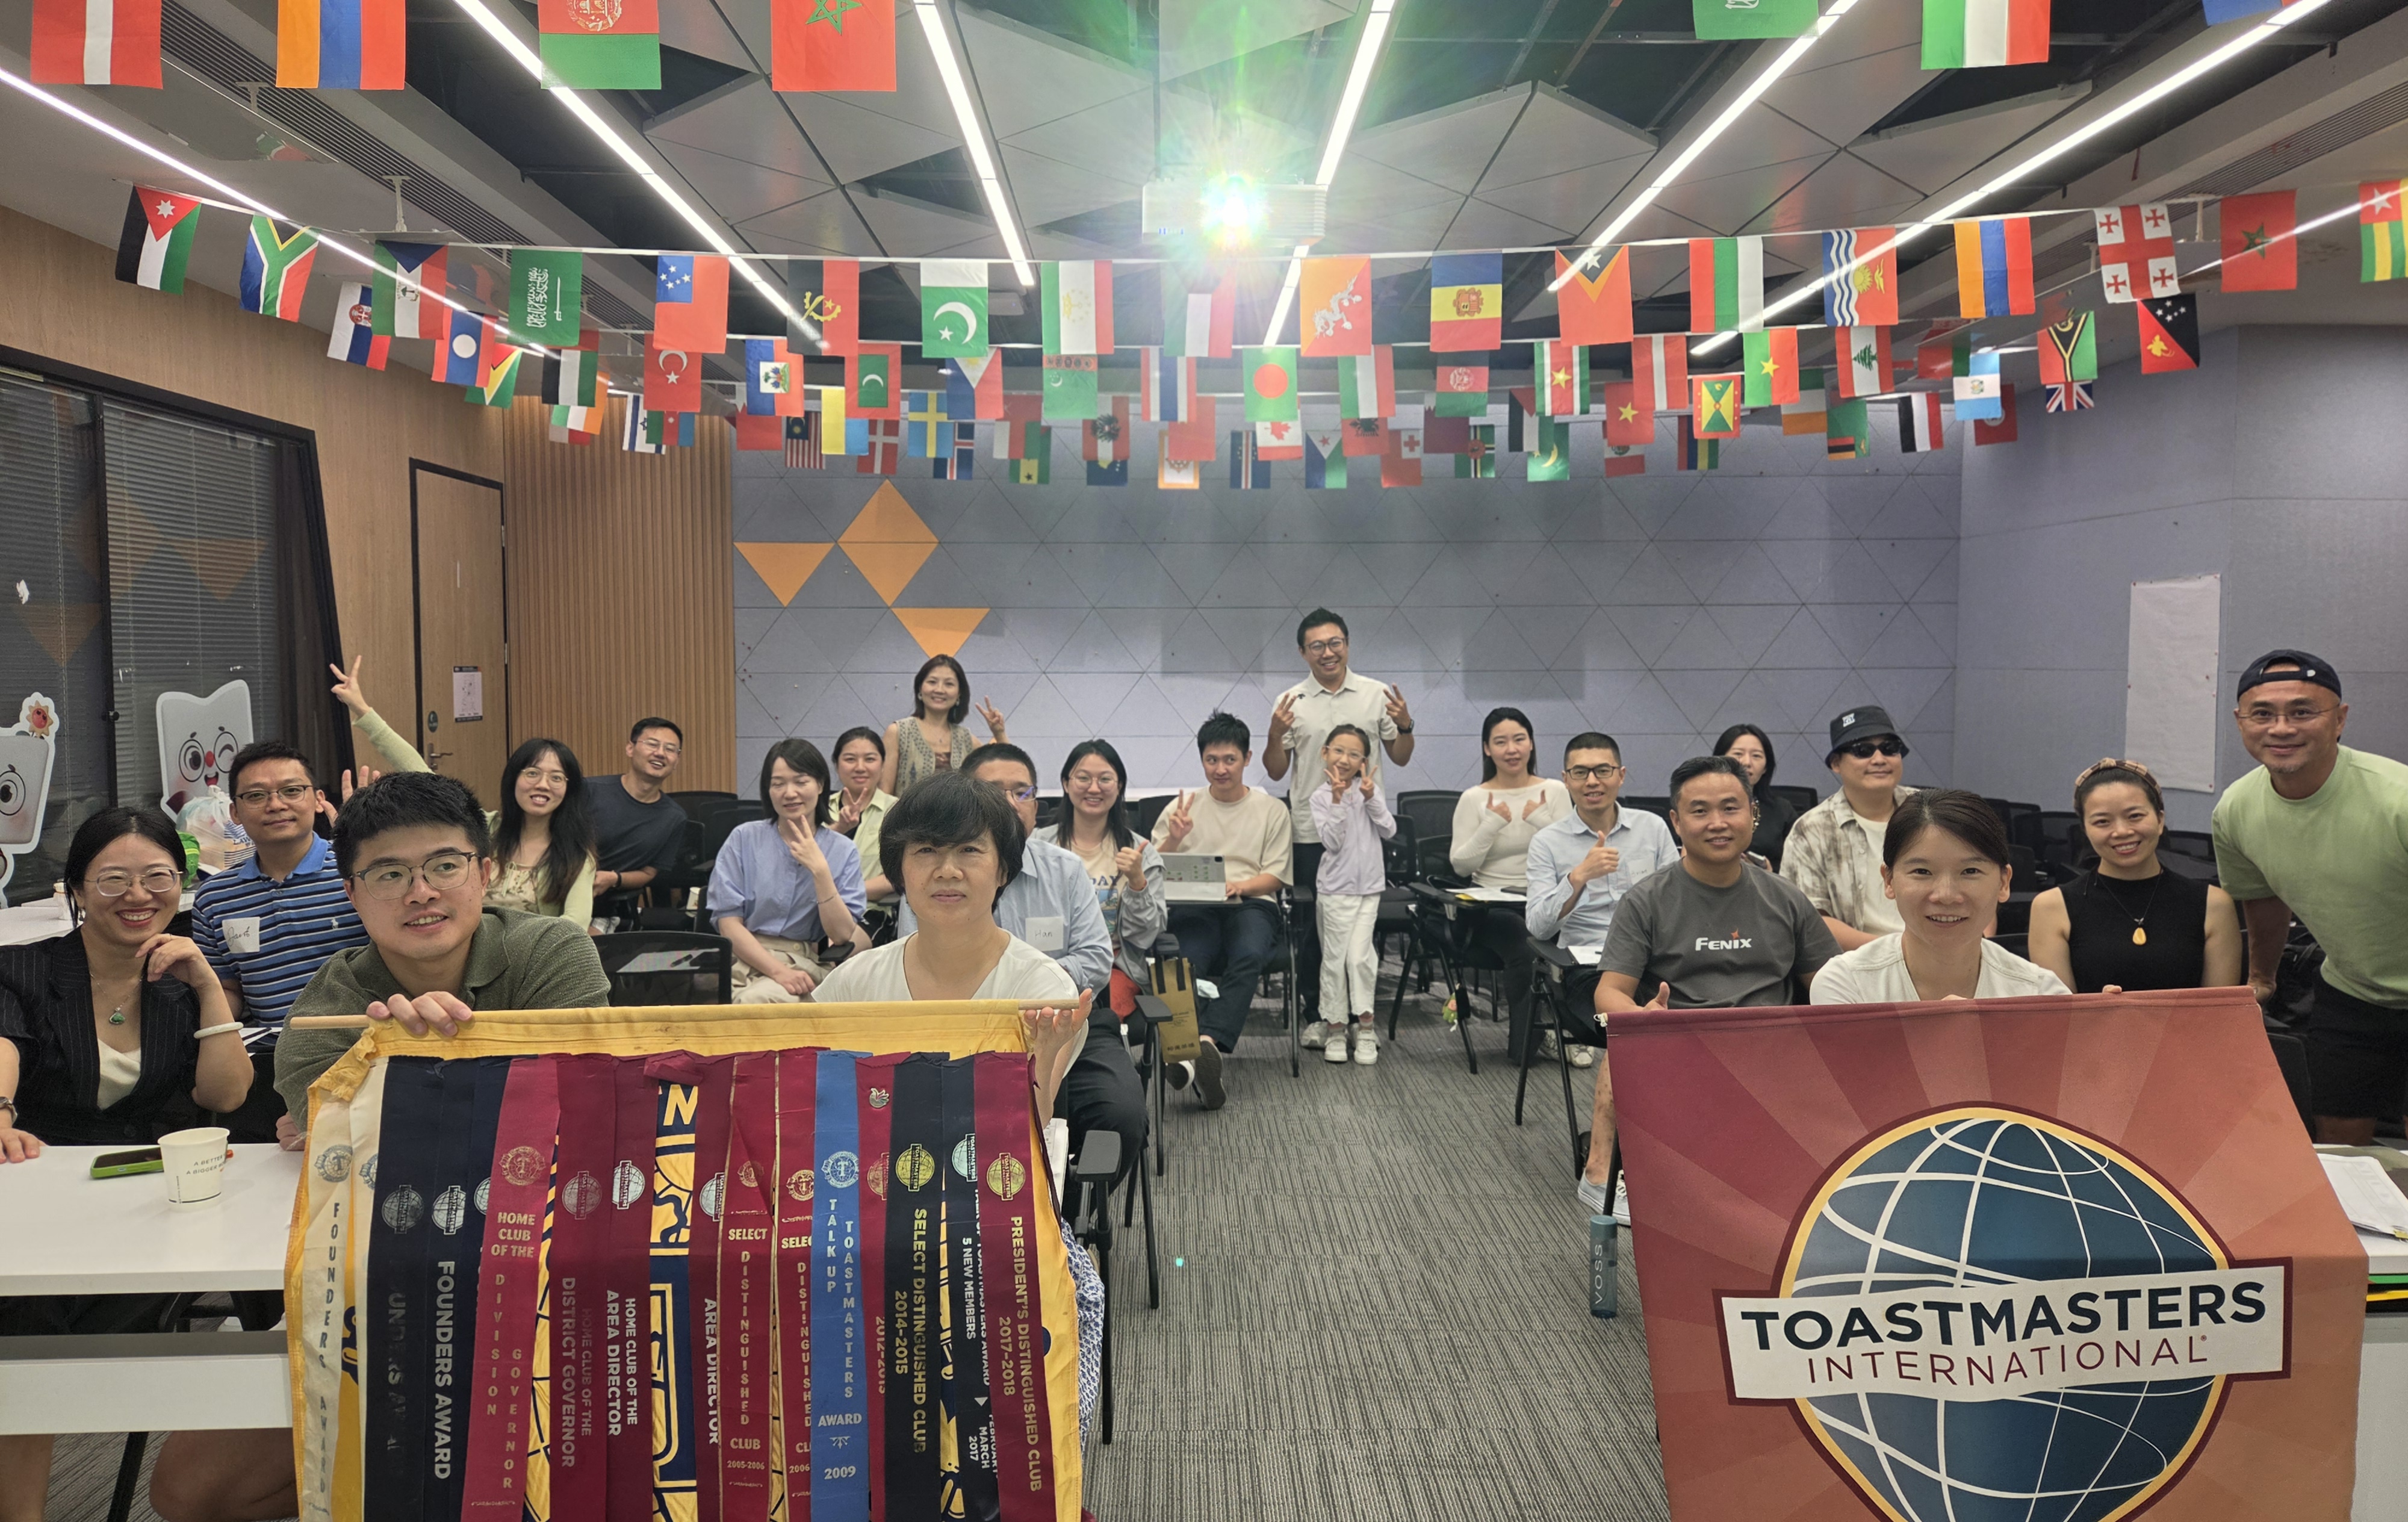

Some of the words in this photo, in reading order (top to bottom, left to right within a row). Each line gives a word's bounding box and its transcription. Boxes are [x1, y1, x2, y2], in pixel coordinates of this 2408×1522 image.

[1035, 930, 1053, 940] Han
[1695, 937, 1752, 951] FENIX
[193, 1165, 217, 1174] BIGGER
[201, 1154, 223, 1165] BETTER
[497, 1212, 536, 1225] HOME
[498, 1228, 531, 1241] CLUB
[728, 1228, 768, 1240] SELECT
[827, 1199, 837, 1258] TALK
[491, 1244, 508, 1256] OF
[510, 1245, 535, 1258] THE
[913, 1208, 927, 1273] SELECT
[962, 1237, 972, 1246] 5
[827, 1266, 836, 1293] UP
[963, 1248, 973, 1278] NEW
[1011, 1216, 1029, 1319] PRESIDENT'S
[319, 1202, 340, 1368] FOUNDERS
[435, 1261, 455, 1387] FOUNDERS
[562, 1278, 576, 1360] DISTRICT
[582, 1308, 592, 1347] HOME
[607, 1290, 619, 1340] AREA
[625, 1298, 636, 1337] HOME
[704, 1298, 717, 1349] AREA
[843, 1220, 855, 1398] TOASTMASTERS
[964, 1281, 976, 1340] MEMBERS
[1740, 1281, 2267, 1351] TOASTMASTERS
[487, 1273, 505, 1415] DIVISION
[740, 1251, 751, 1425] DISTINGUISHED
[895, 1290, 908, 1375] 2014-2015
[913, 1277, 926, 1405] DISTINGUISHED
[582, 1350, 592, 1385] CLUB
[625, 1340, 637, 1374] CLUB
[999, 1317, 1016, 1396] 2017-2018
[1808, 1336, 2208, 1387] INTERNATIONAL
[581, 1388, 592, 1407] OF
[607, 1345, 621, 1436] DIRECTOR
[626, 1378, 638, 1396] OF
[1017, 1324, 1038, 1445] DISTINGUISHED
[503, 1348, 522, 1488] GOVERNOR
[562, 1365, 576, 1467] GOVERNOR
[581, 1411, 592, 1436] THE
[627, 1399, 638, 1425] THE
[818, 1413, 862, 1427] AWARD
[913, 1409, 926, 1453] CLUB
[434, 1393, 452, 1479] AWARD
[730, 1438, 761, 1450] CLUB
[969, 1436, 979, 1461] 2017
[979, 1426, 990, 1468] MARCH
[727, 1459, 765, 1470] 2005-2006
[824, 1465, 856, 1480] 2009
[1028, 1450, 1042, 1491] CLUB
